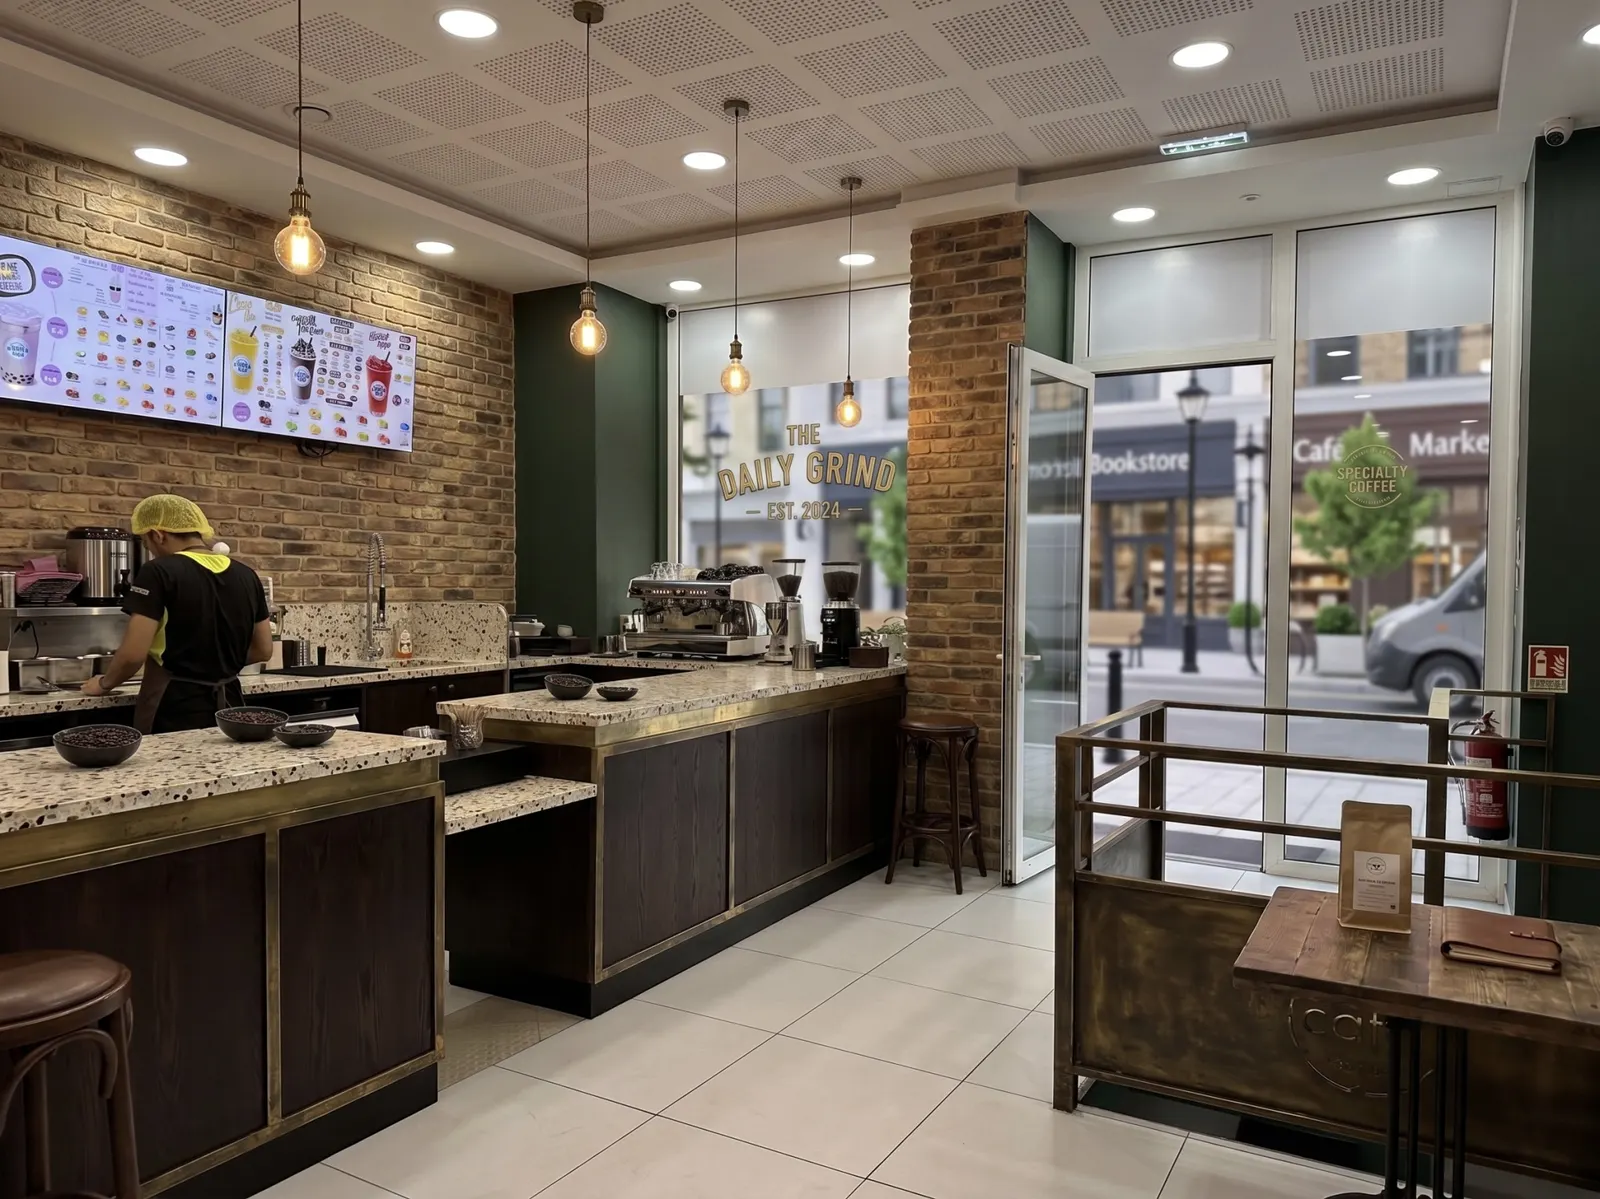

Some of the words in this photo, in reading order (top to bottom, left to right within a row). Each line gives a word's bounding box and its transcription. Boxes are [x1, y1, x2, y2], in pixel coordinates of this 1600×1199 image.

[786, 423, 821, 446] THE
[1091, 449, 1189, 476] Bookstore
[1336, 465, 1408, 480] SPECIALTY
[717, 453, 795, 501] DAILY
[806, 450, 897, 493] GRIND
[1349, 479, 1397, 493] COFFEE
[767, 501, 798, 520] EST.
[801, 500, 841, 520] 2024
